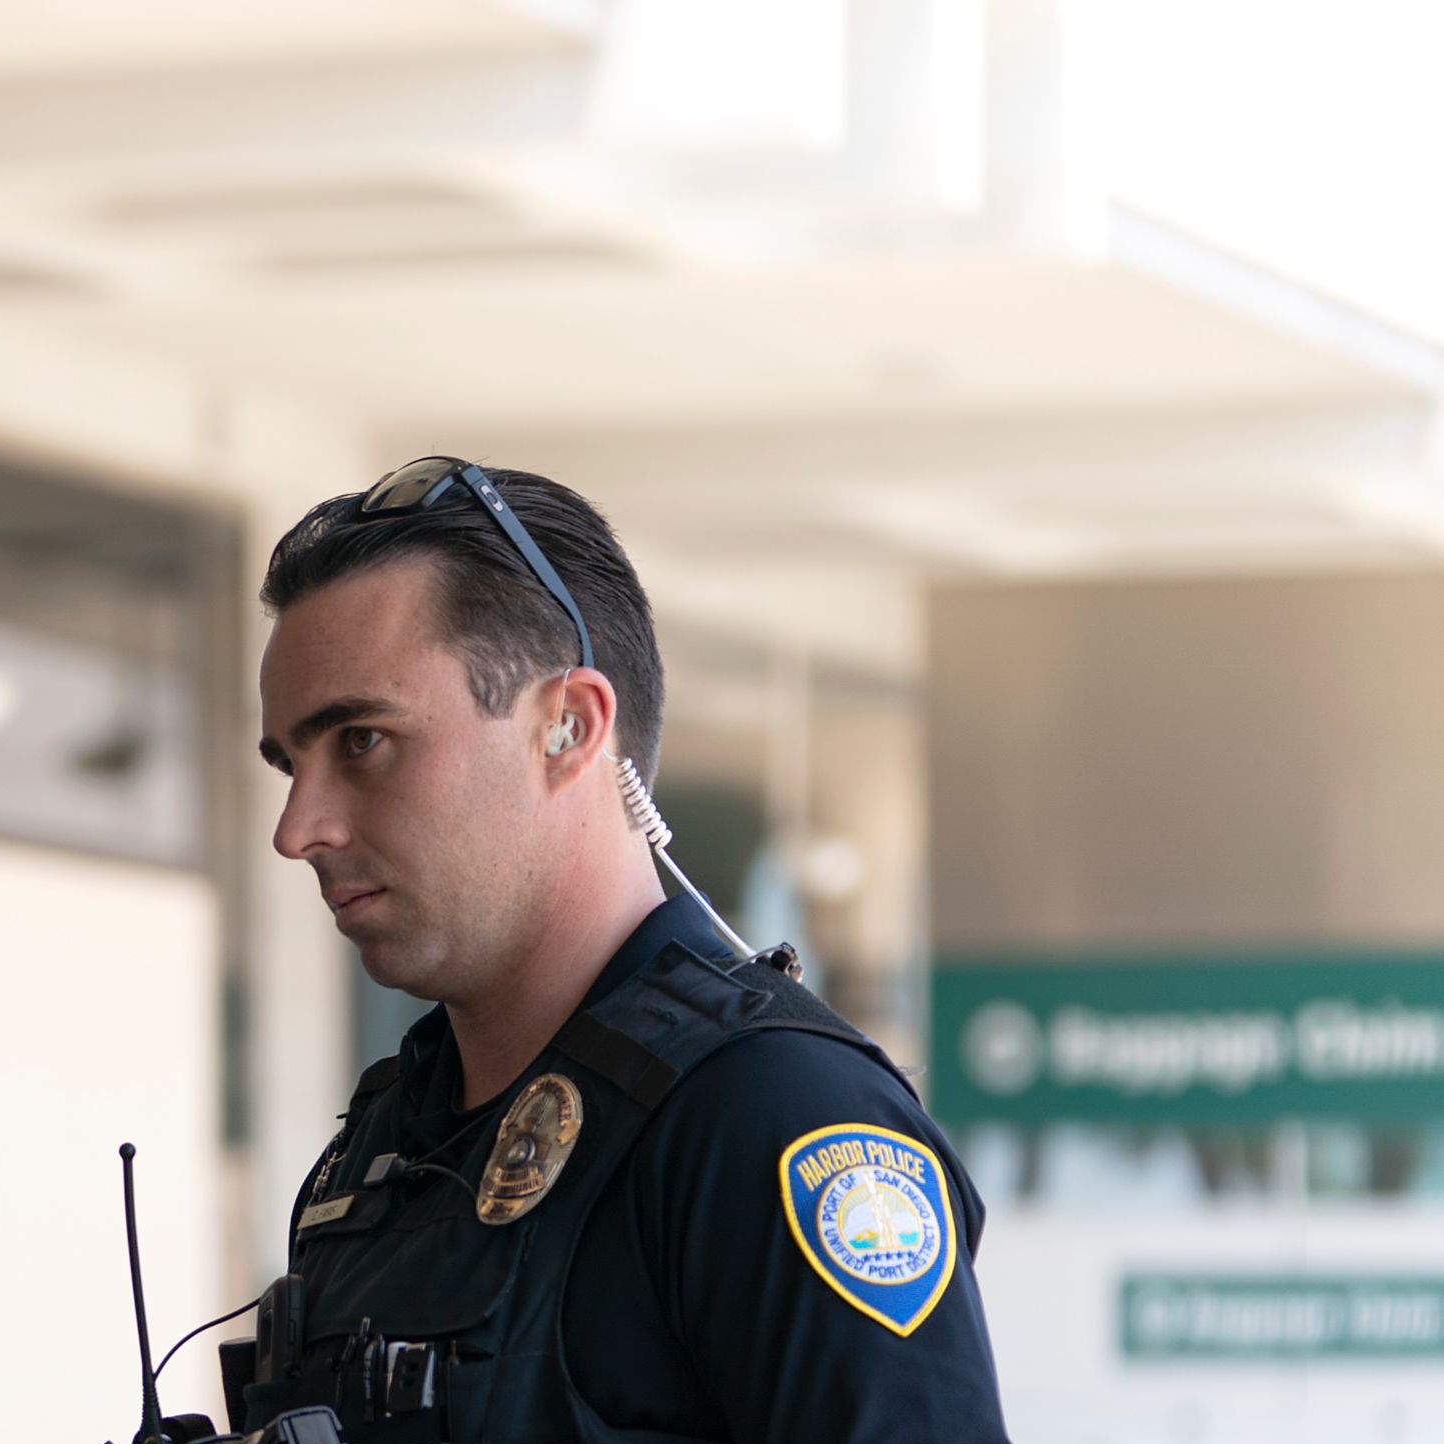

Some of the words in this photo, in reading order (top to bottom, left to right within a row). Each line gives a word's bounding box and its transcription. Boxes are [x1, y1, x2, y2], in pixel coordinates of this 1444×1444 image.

[796, 1140, 866, 1192] HARBOR
[865, 1140, 926, 1184] POLICE
[822, 1187, 845, 1221] PORT
[839, 1173, 857, 1190] OF
[874, 1169, 901, 1188] SAN
[903, 1183, 931, 1219] DIEGO
[824, 1226, 865, 1271] UNIFIED
[868, 1264, 905, 1279] PORT
[909, 1223, 936, 1272] DISTRICT
